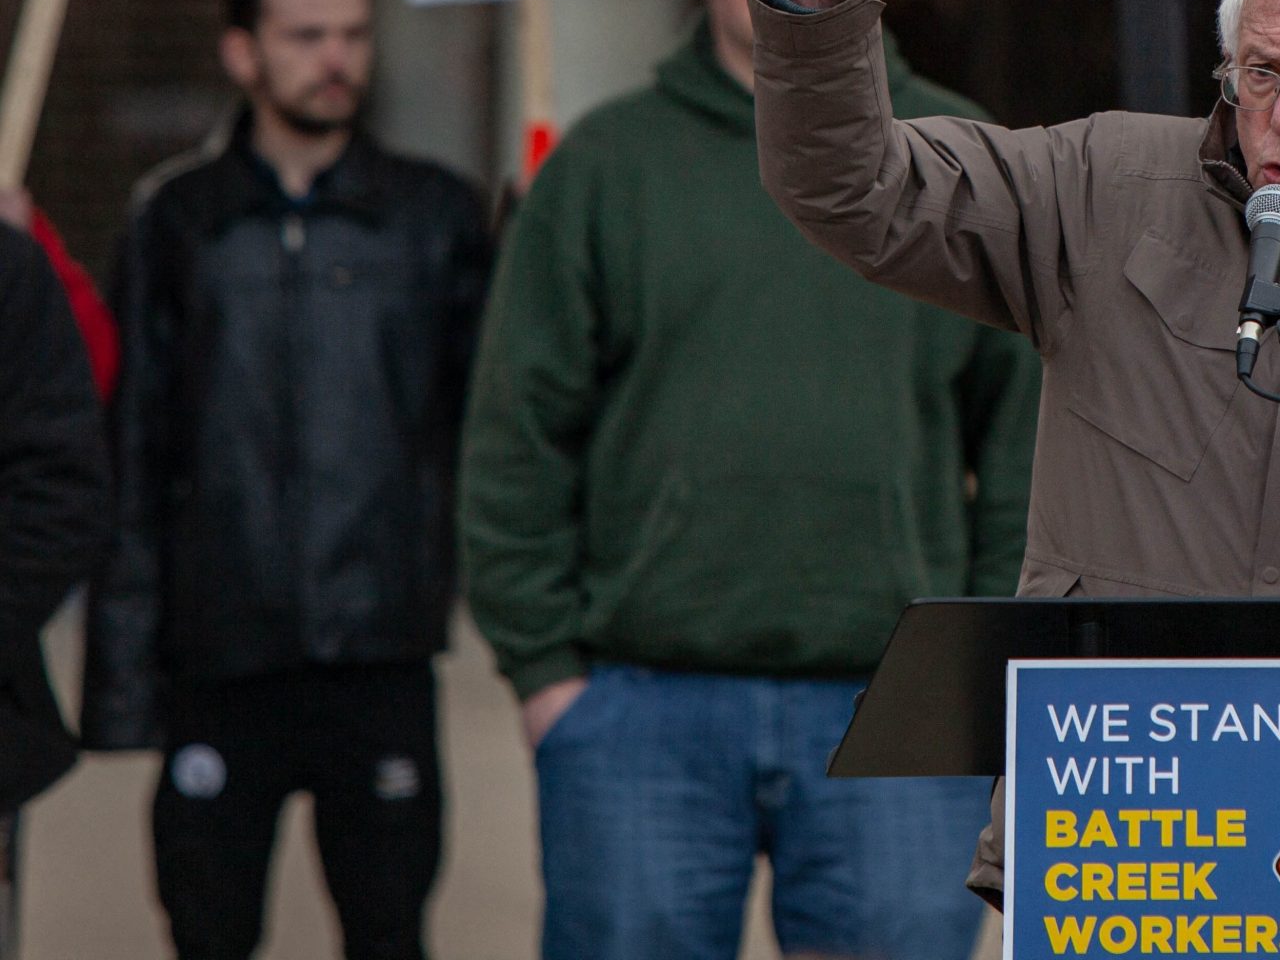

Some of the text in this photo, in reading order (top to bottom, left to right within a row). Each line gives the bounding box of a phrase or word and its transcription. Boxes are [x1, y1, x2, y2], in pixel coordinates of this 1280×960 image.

[1047, 704, 1130, 742] WE
[1046, 756, 1180, 795] WITH
[1045, 809, 1247, 848] BATTLE
[1044, 862, 1218, 902] CREEK
